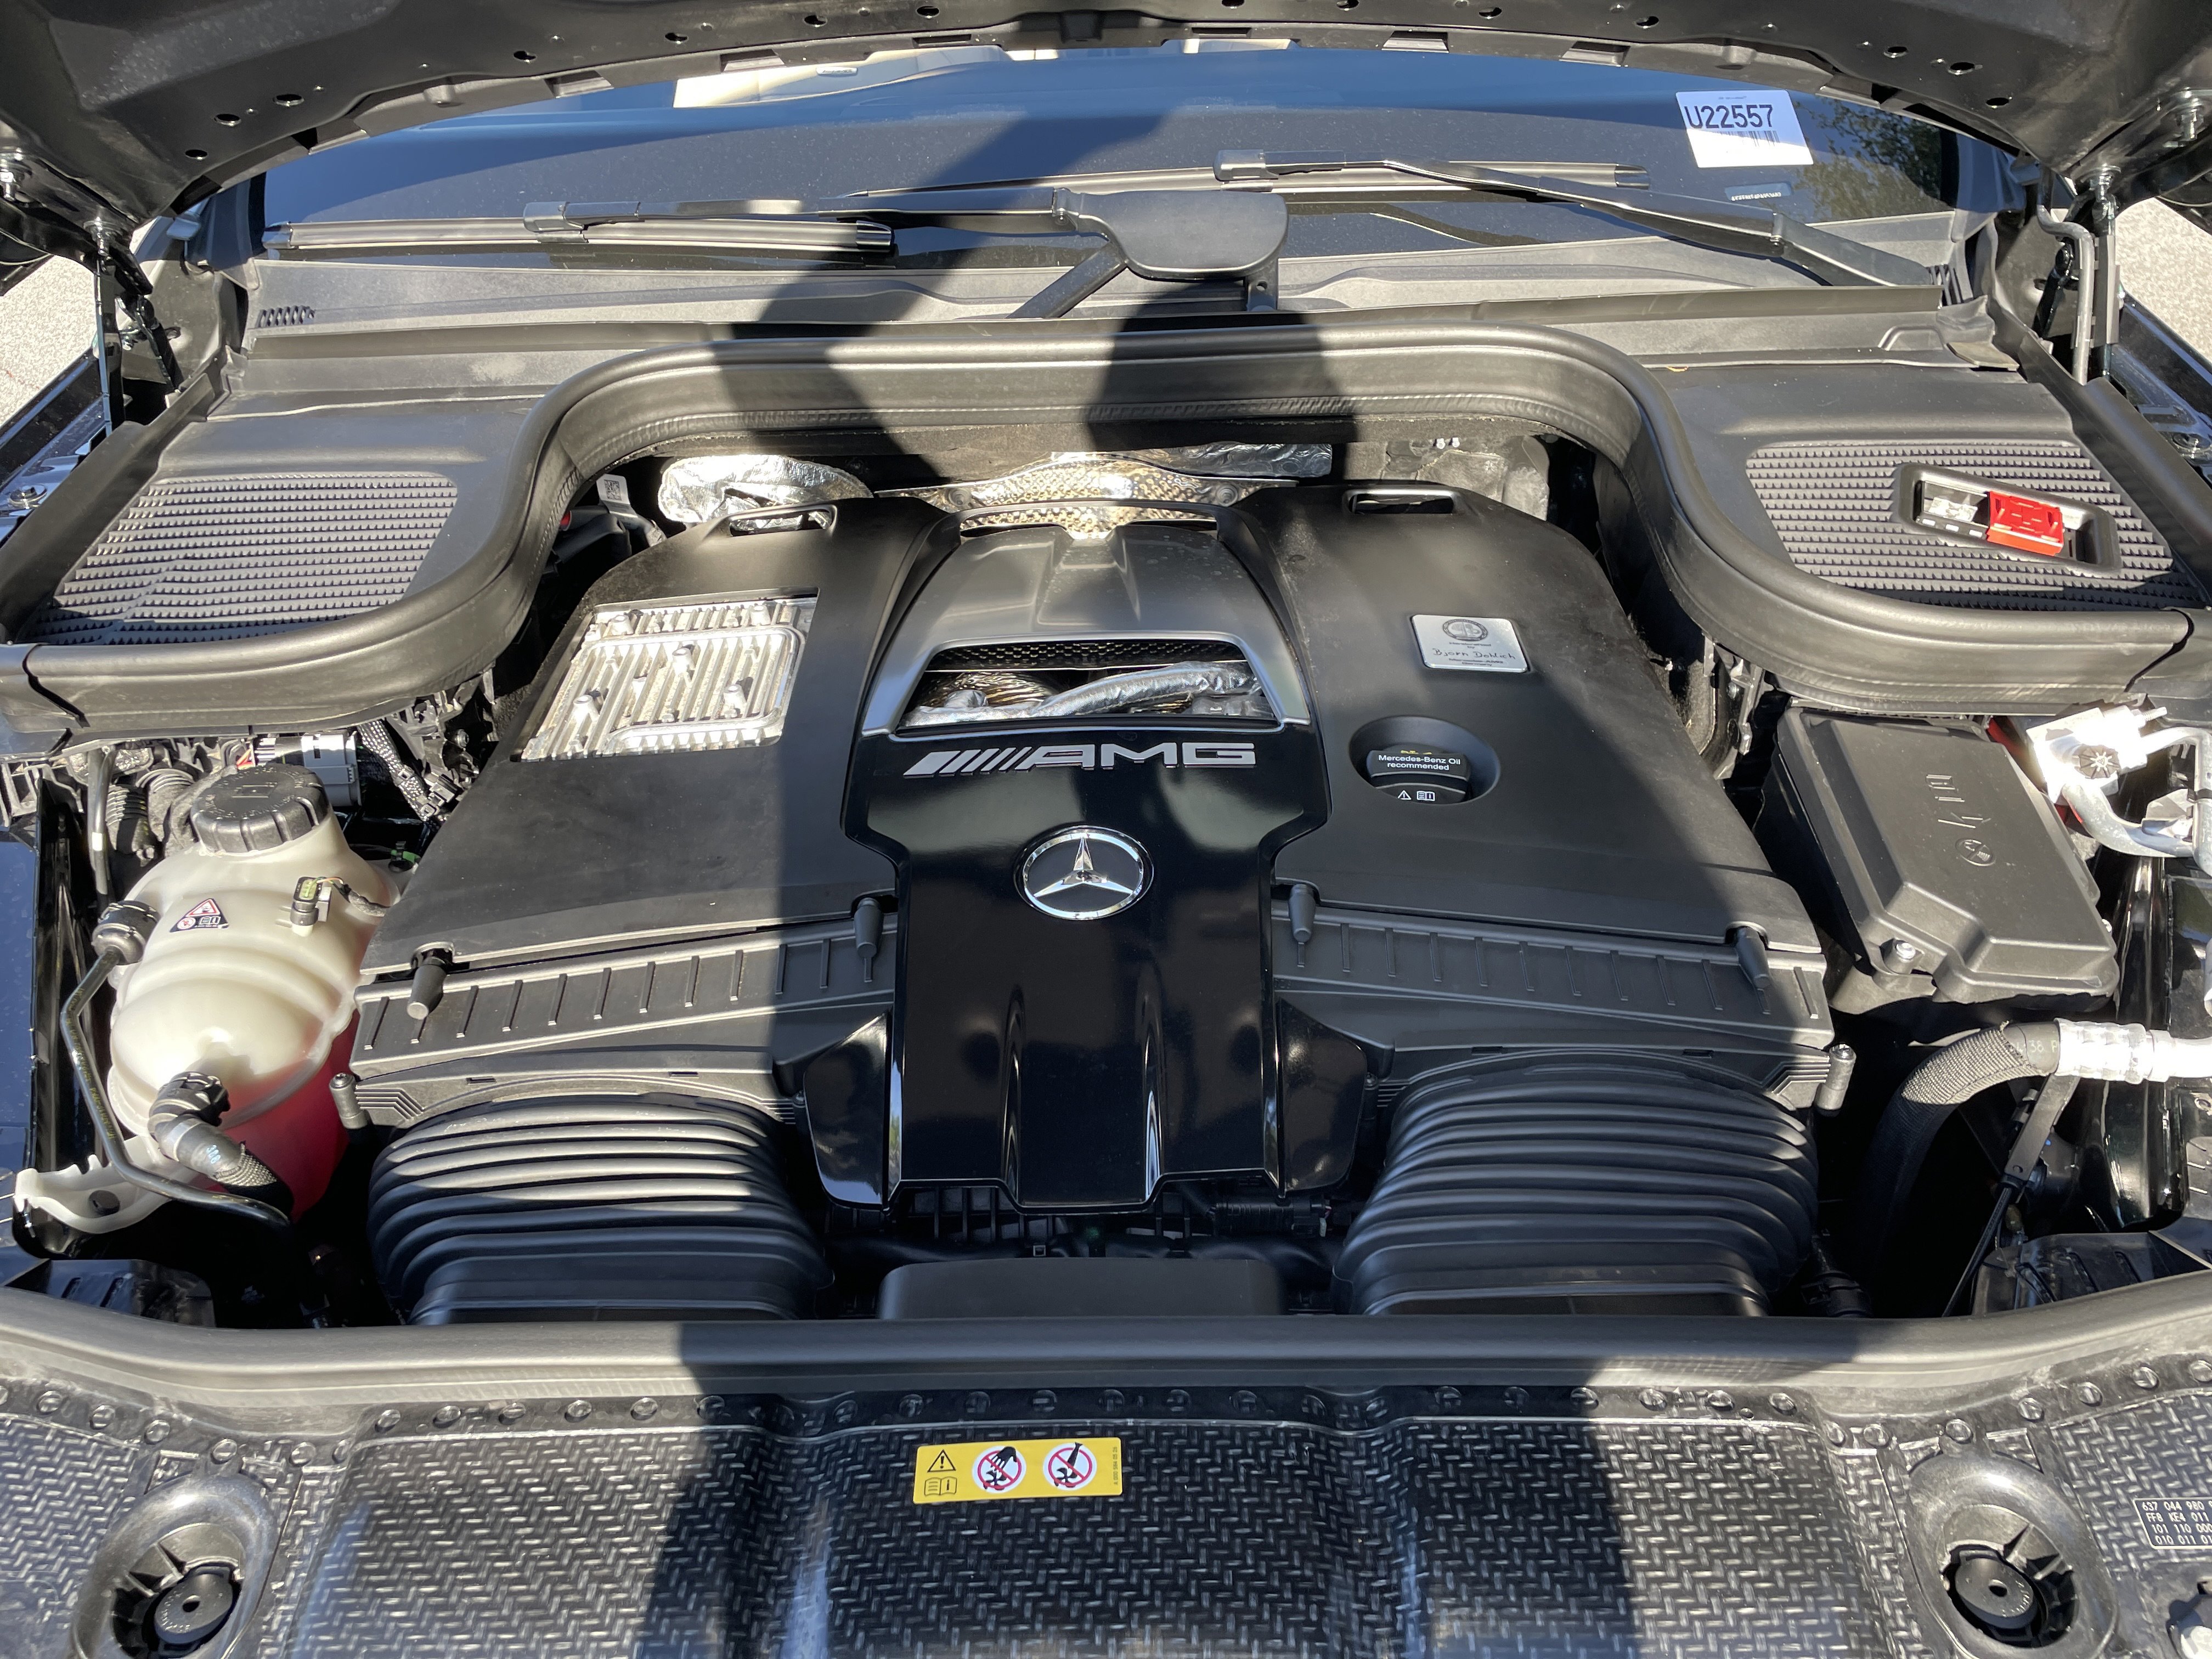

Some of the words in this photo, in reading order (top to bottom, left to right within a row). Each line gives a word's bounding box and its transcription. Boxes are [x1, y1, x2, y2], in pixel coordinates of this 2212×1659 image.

[1684, 104, 1773, 128] U22557
[1015, 742, 1257, 769] AMG
[1378, 754, 1446, 764] Mercedes-Benz
[1387, 762, 1449, 771] recommended
[2142, 1501, 2158, 1511] 637
[2163, 1501, 2182, 1511] 044
[2185, 1500, 2205, 1510] 980
[2146, 1512, 2164, 1522] FF8
[2168, 1512, 2186, 1522] KE4
[2191, 1511, 2209, 1522] 011
[2151, 1523, 2169, 1534] 101
[2174, 1523, 2192, 1533] 110
[2155, 1535, 2175, 1545] 010
[2177, 1534, 2197, 1545] 011
